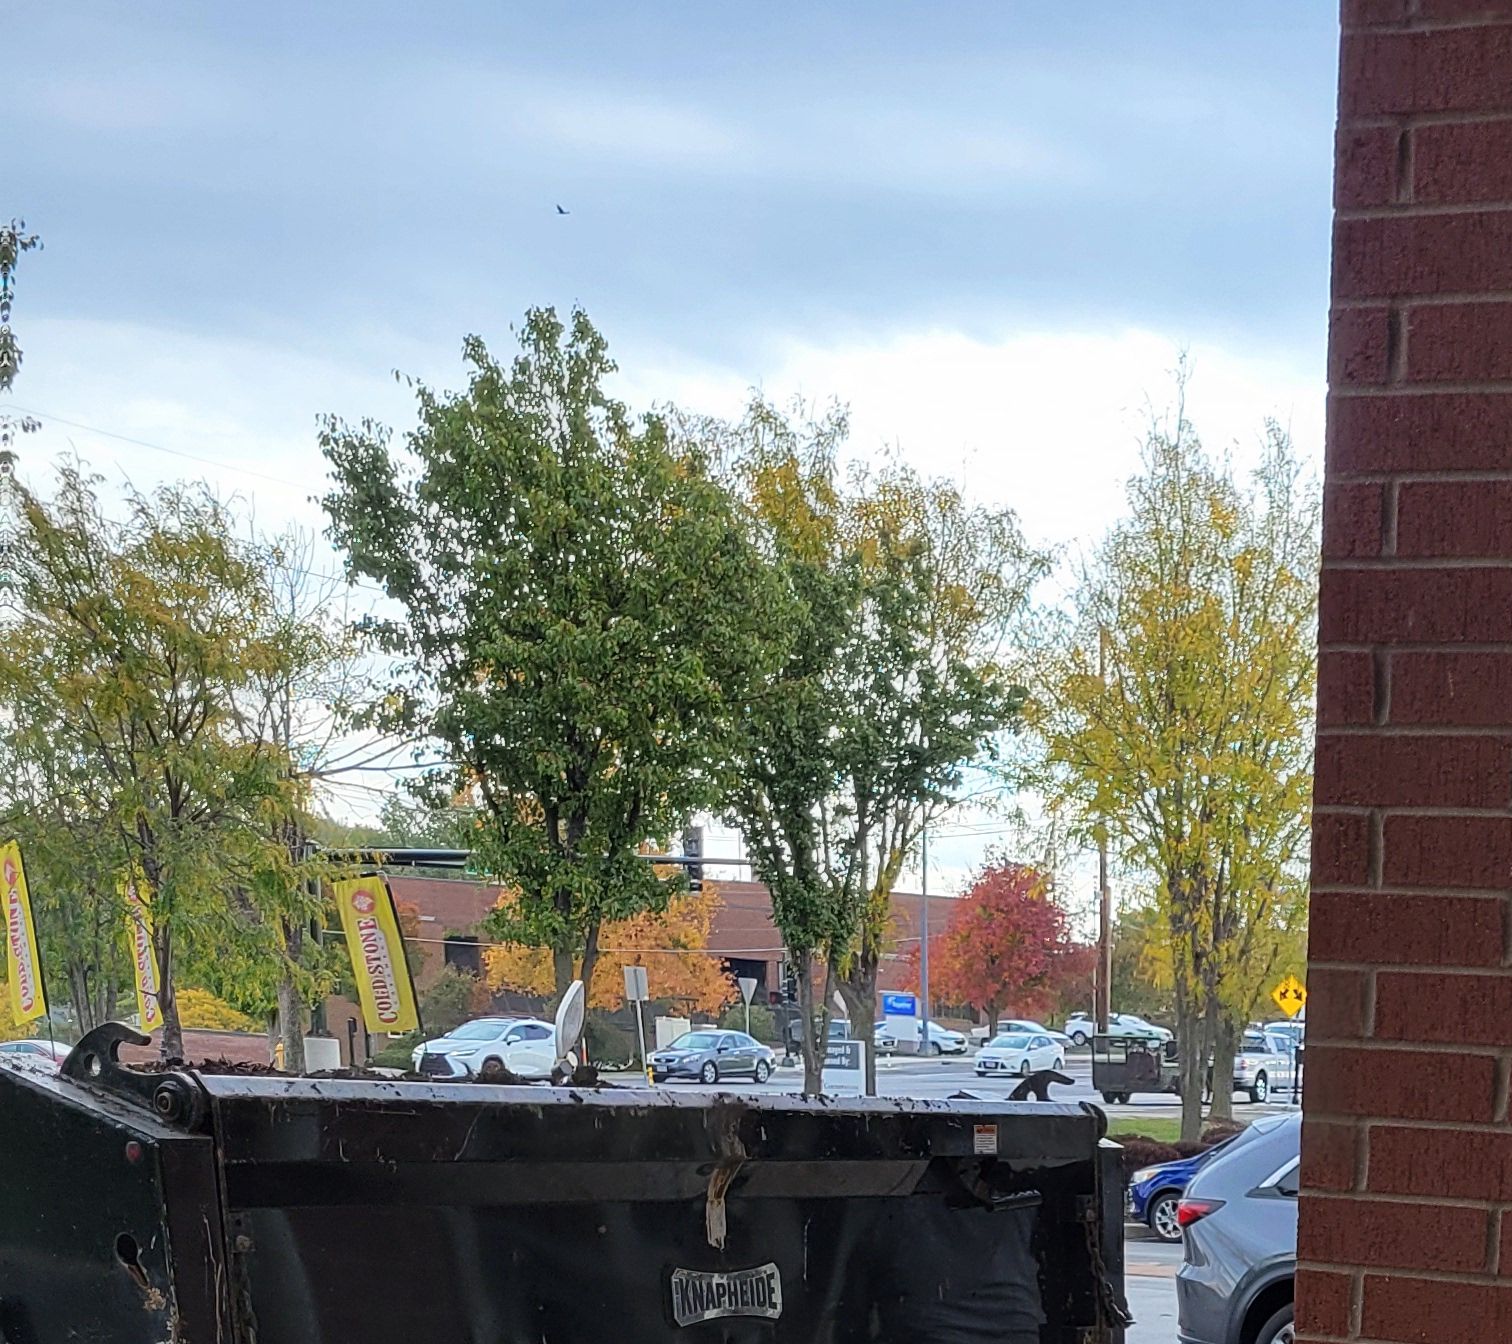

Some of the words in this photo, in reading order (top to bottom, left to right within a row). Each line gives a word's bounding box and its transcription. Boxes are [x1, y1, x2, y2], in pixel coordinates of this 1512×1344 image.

[357, 917, 385, 976] STONE
[372, 979, 398, 1024] COLD
[676, 1271, 778, 1318] KNAPHEIDE
